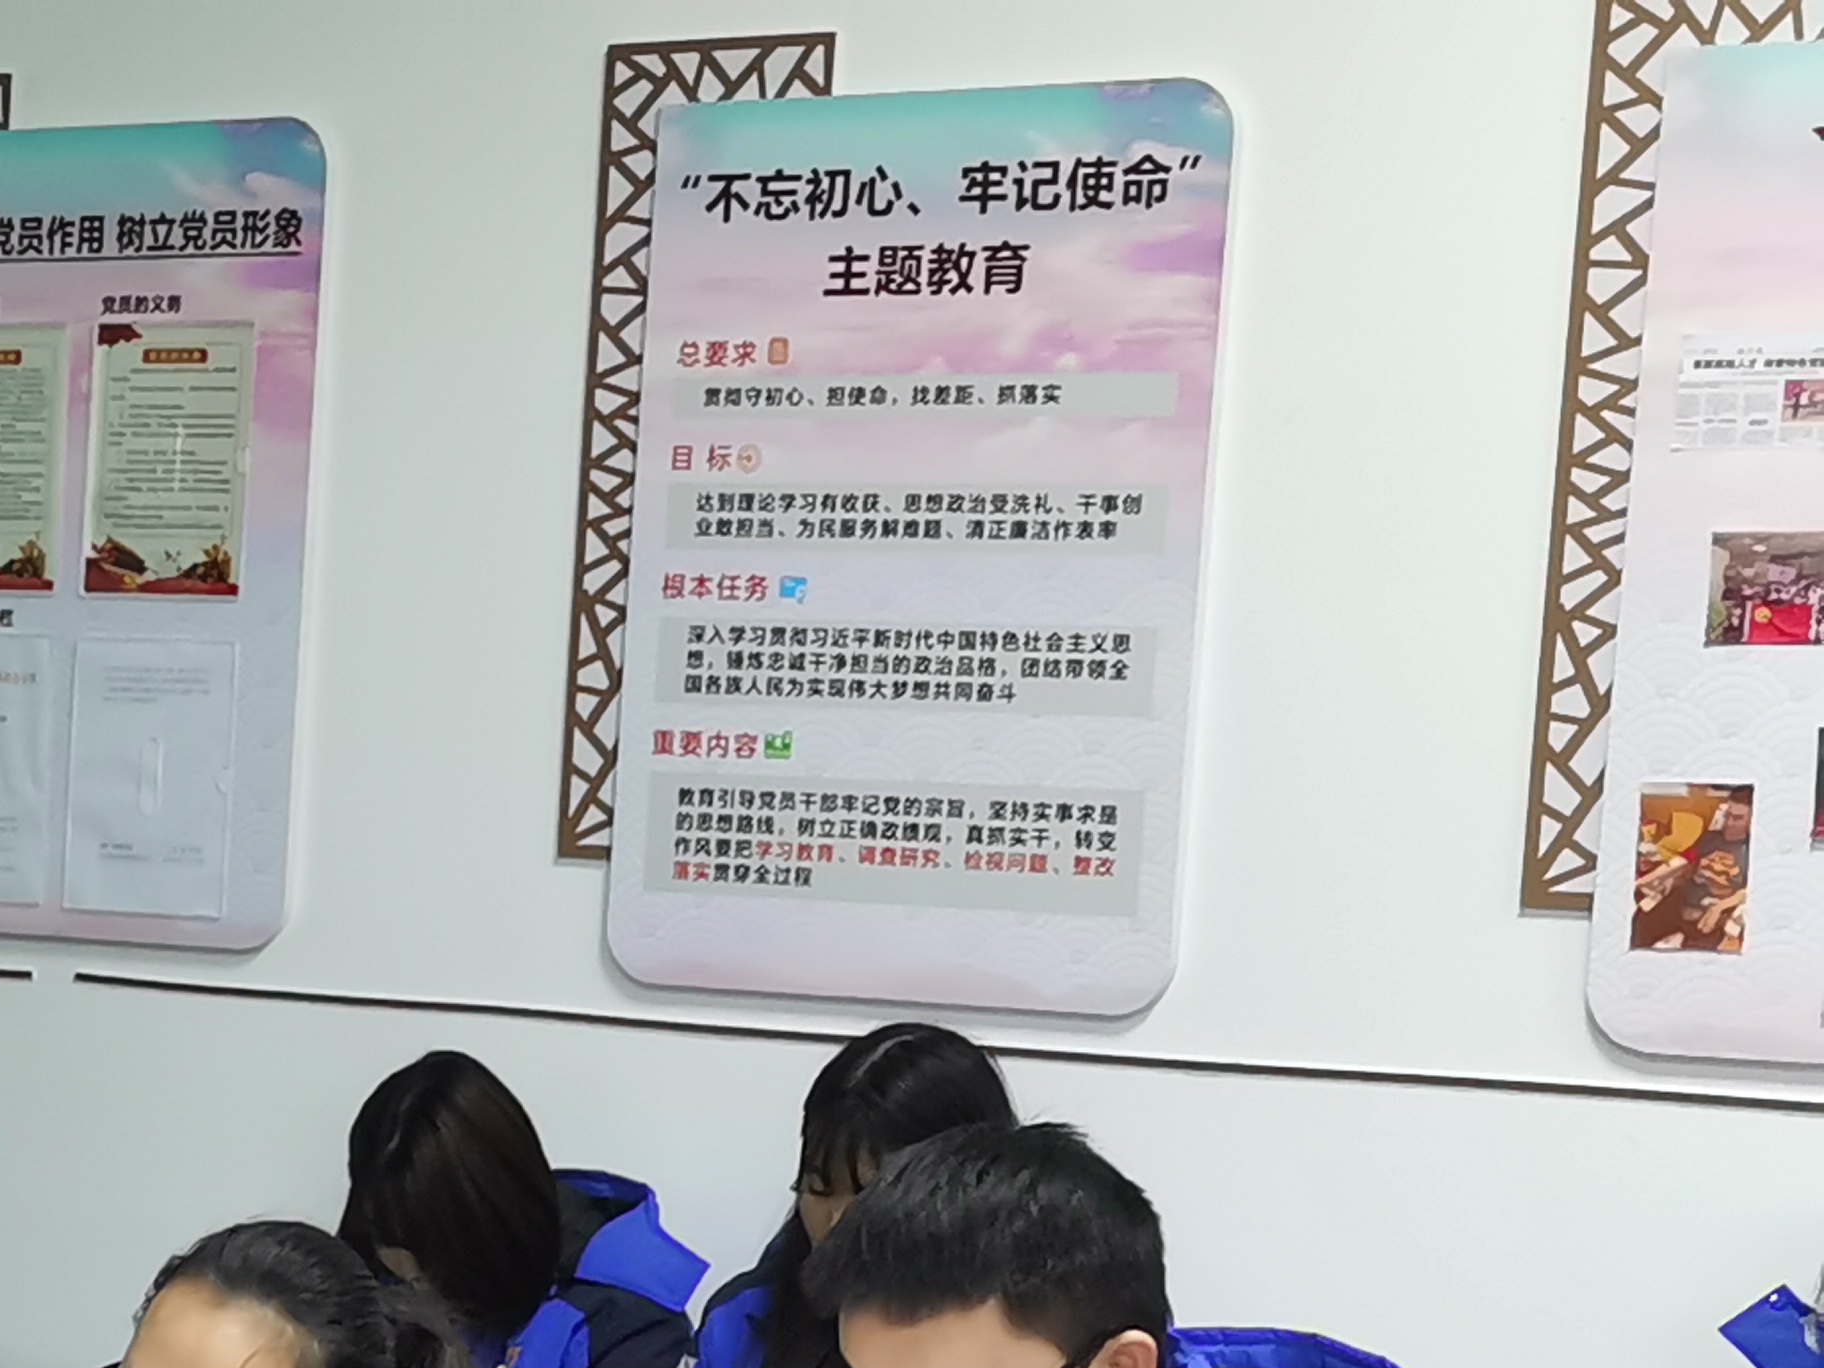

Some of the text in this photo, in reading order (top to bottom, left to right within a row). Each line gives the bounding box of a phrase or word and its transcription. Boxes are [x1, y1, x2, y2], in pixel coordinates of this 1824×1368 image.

[680, 154, 1202, 223] “不忘初心、牢记使命”
[117, 207, 303, 252] 树立党员形象
[822, 241, 1031, 298] 主题教育
[676, 340, 758, 368] 总要求
[671, 444, 733, 472] 目标
[661, 573, 770, 602] 根本任务
[652, 730, 758, 760] 重要内容
[672, 860, 813, 887] 落实贯穿全过程
